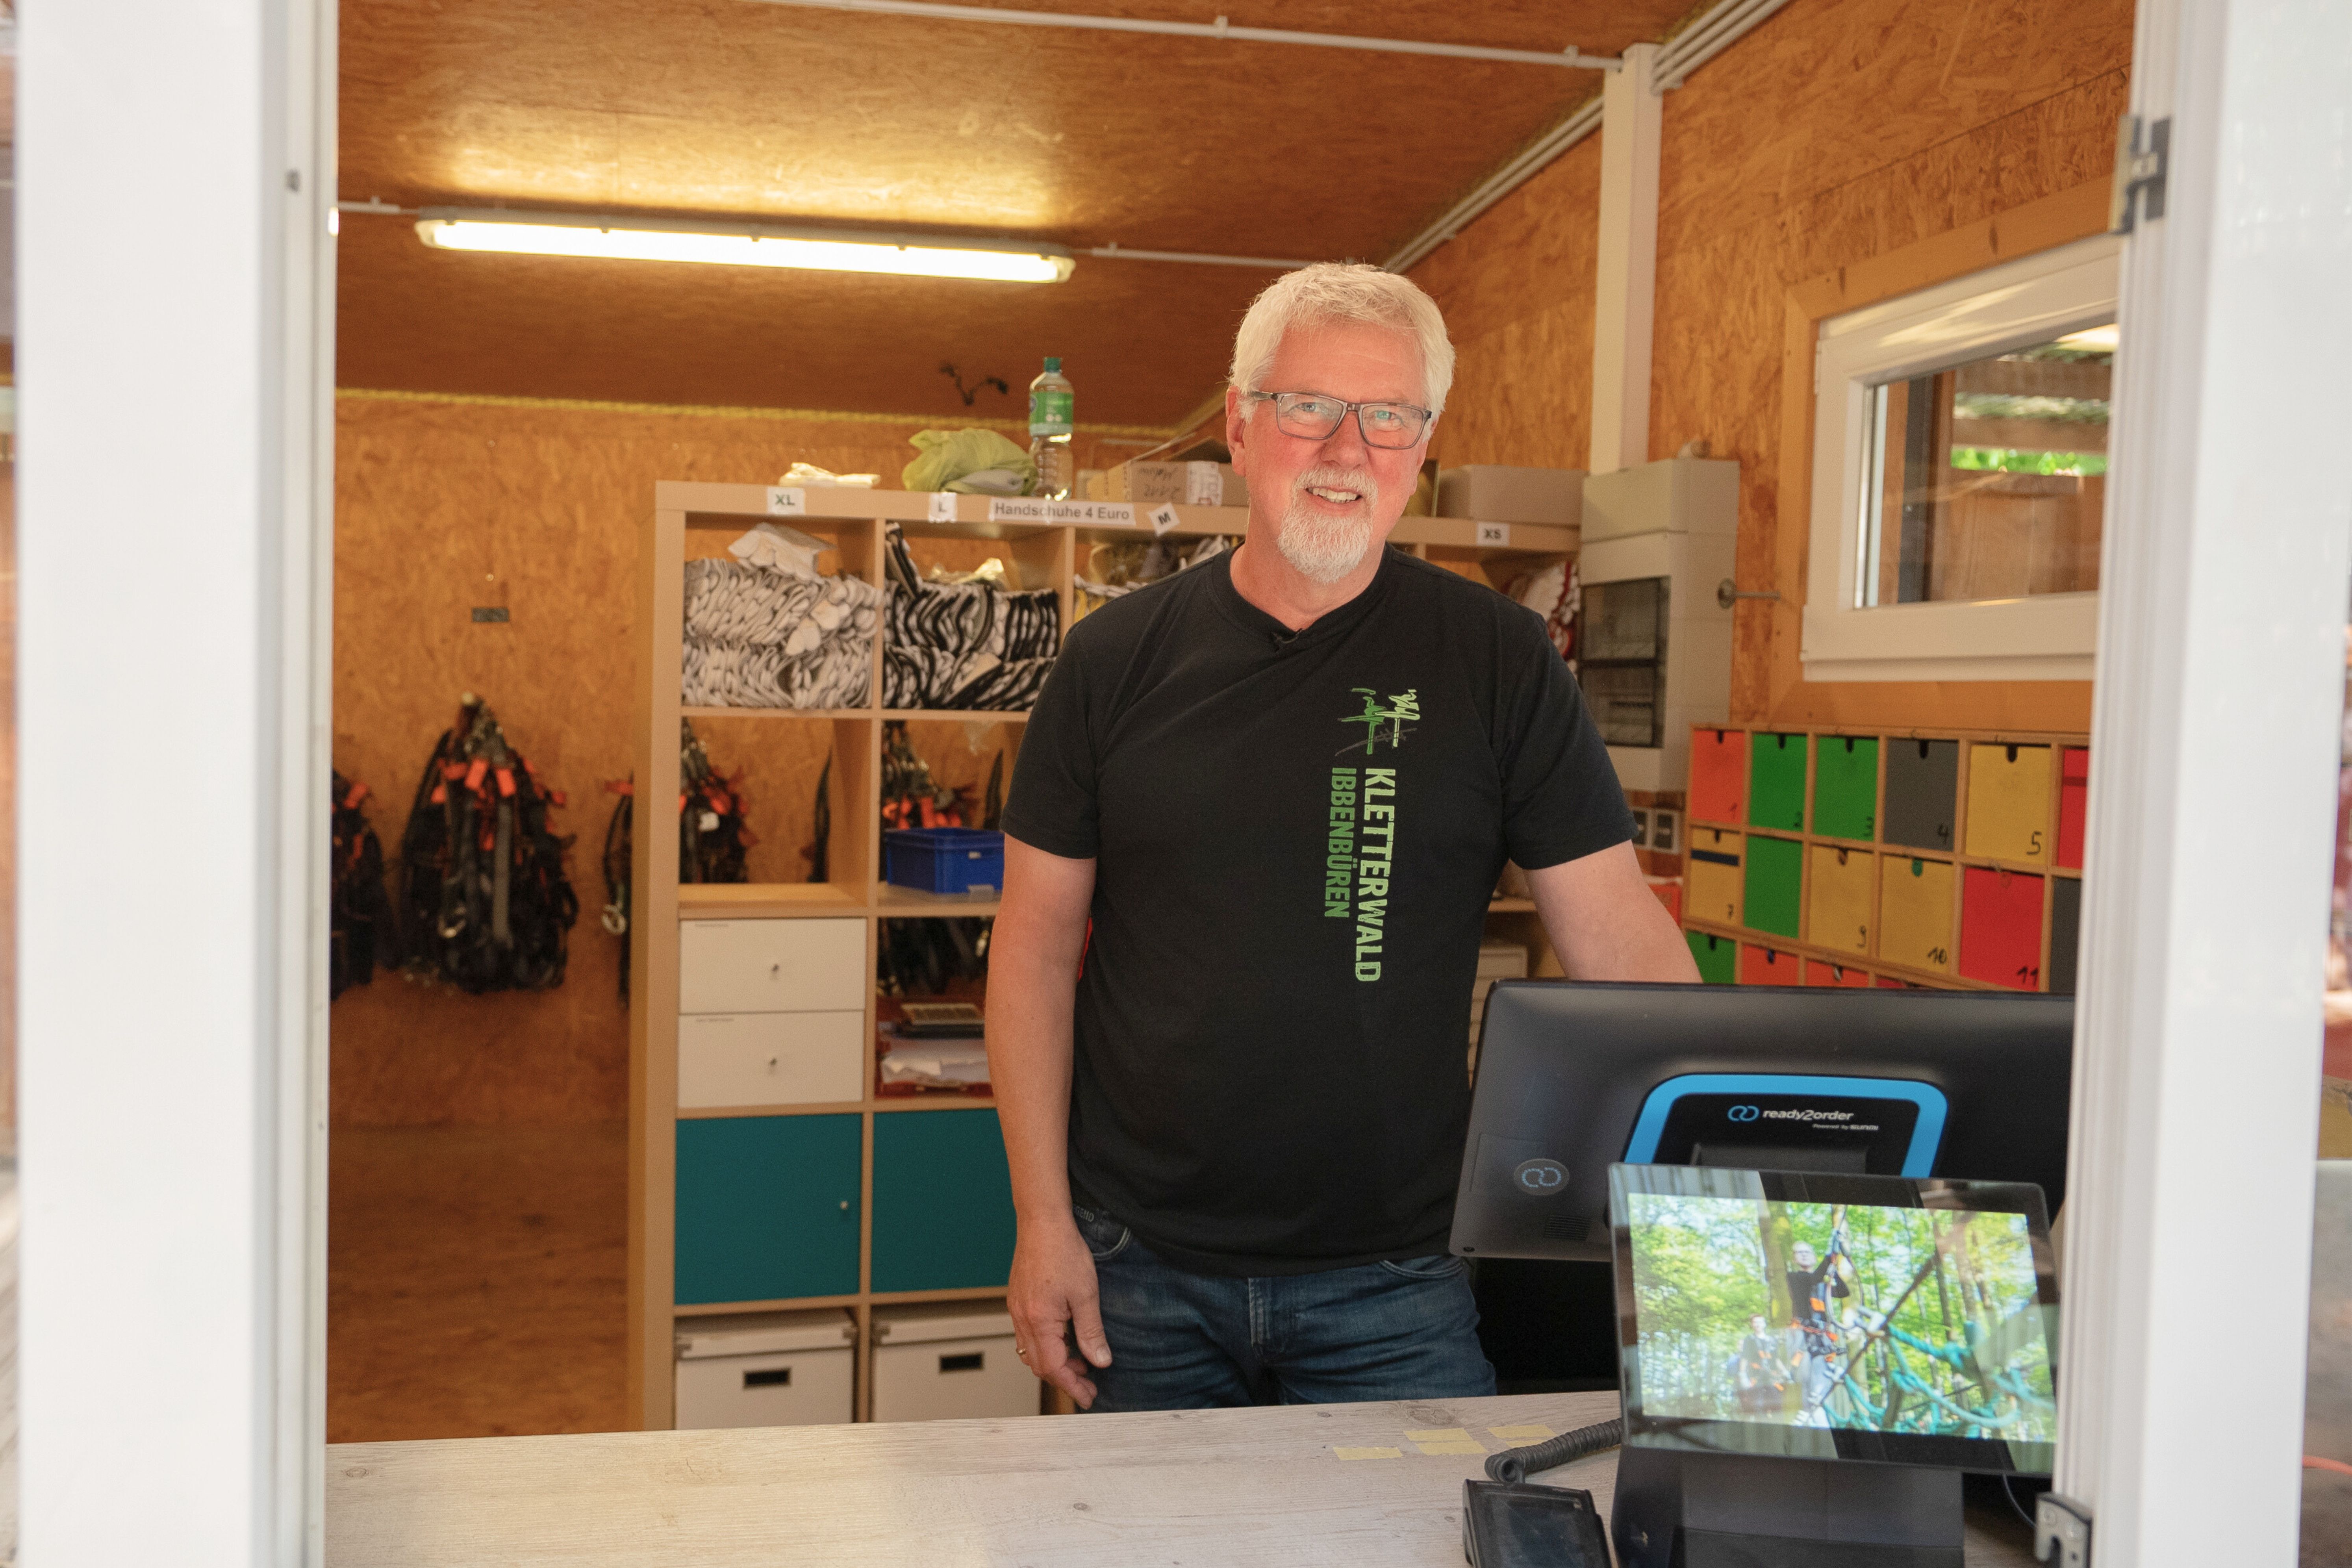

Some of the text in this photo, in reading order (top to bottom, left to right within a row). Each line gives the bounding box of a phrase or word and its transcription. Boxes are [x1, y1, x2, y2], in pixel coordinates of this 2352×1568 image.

[775, 493, 795, 506] XL
[938, 501, 947, 512] L
[995, 502, 1129, 519] Handschuhe 4 Euro
[1158, 511, 1171, 525] M
[1484, 528, 1502, 540] XS
[1793, 811, 1803, 828] 2
[1863, 816, 1874, 837] 3
[1324, 767, 1358, 917] IBBENBÜREN
[1937, 824, 1948, 845] 4
[2026, 831, 2042, 855] 5
[1355, 768, 1396, 981] KLETTERWALD
[1857, 925, 1867, 949] 9
[1928, 946, 1947, 964] 10
[2017, 966, 2039, 986] 11
[1763, 1109, 1854, 1121] ready2order
